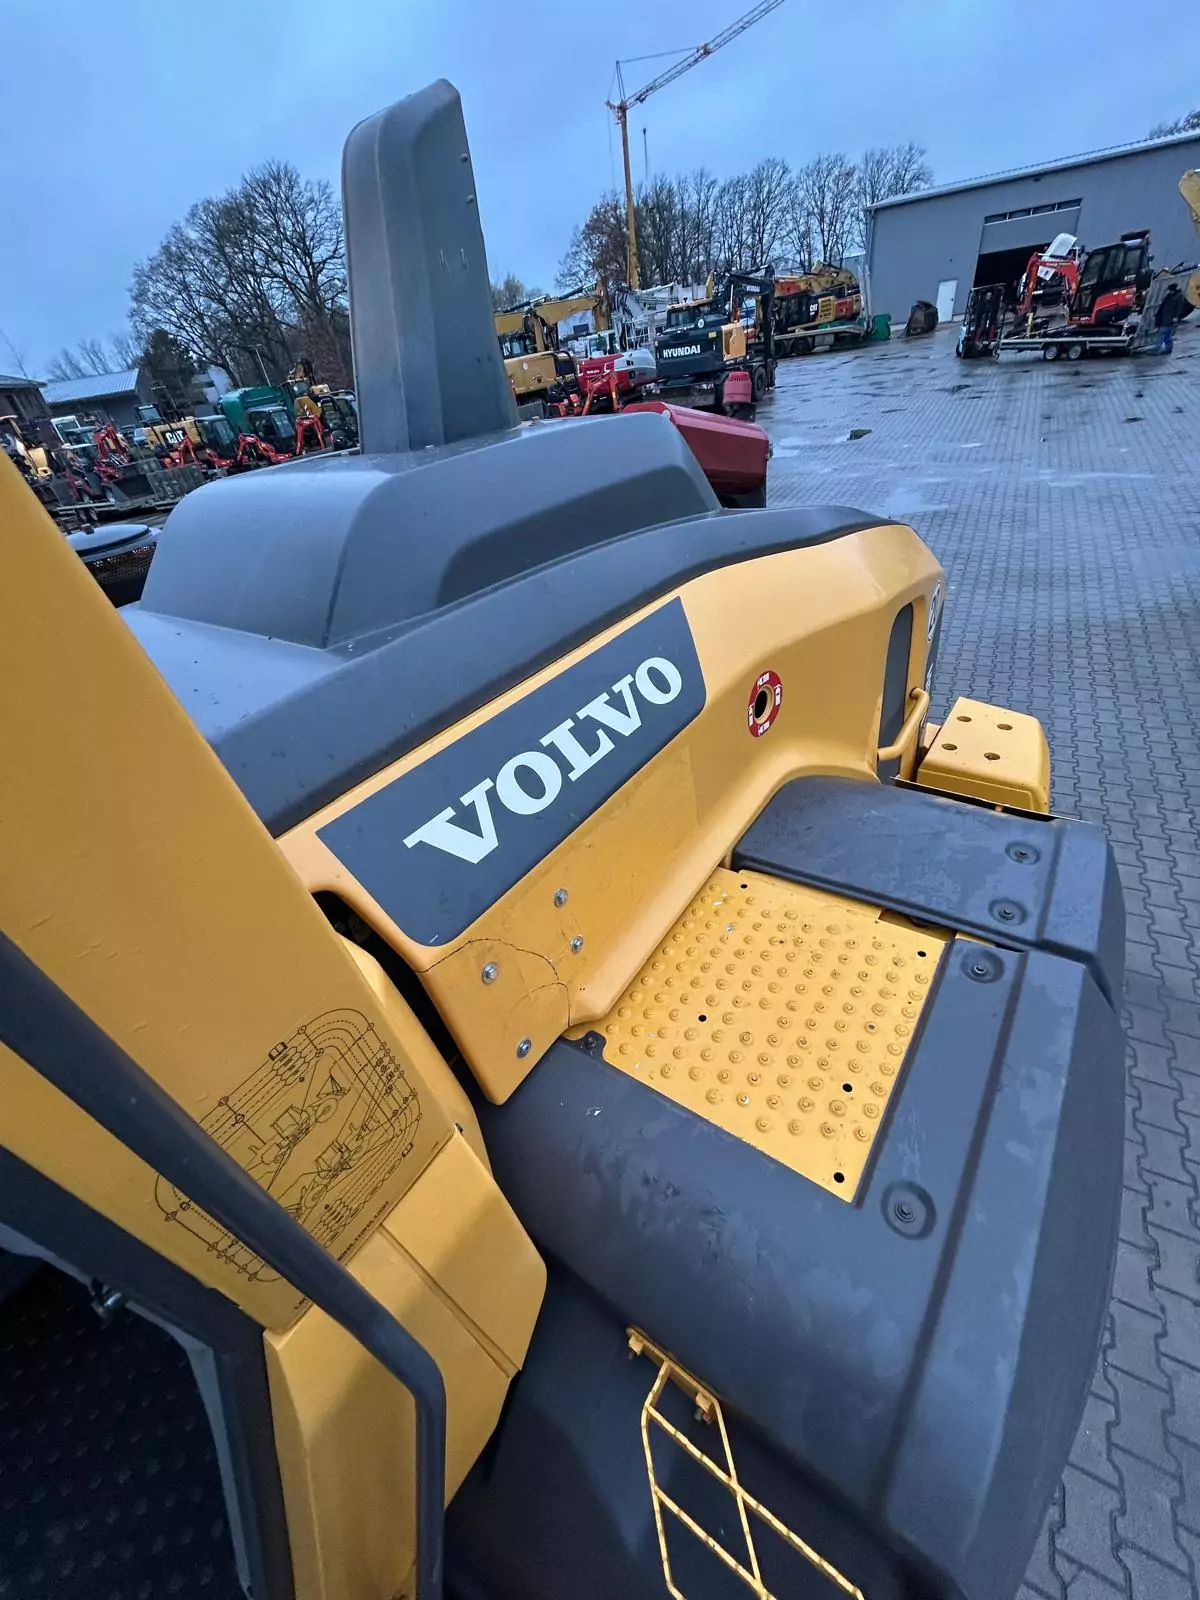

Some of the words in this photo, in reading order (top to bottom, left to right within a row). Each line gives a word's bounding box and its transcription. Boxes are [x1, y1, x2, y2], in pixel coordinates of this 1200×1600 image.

[663, 344, 701, 358] HYUNDAI
[165, 430, 184, 444] CAT
[403, 657, 682, 864] VOLVO
